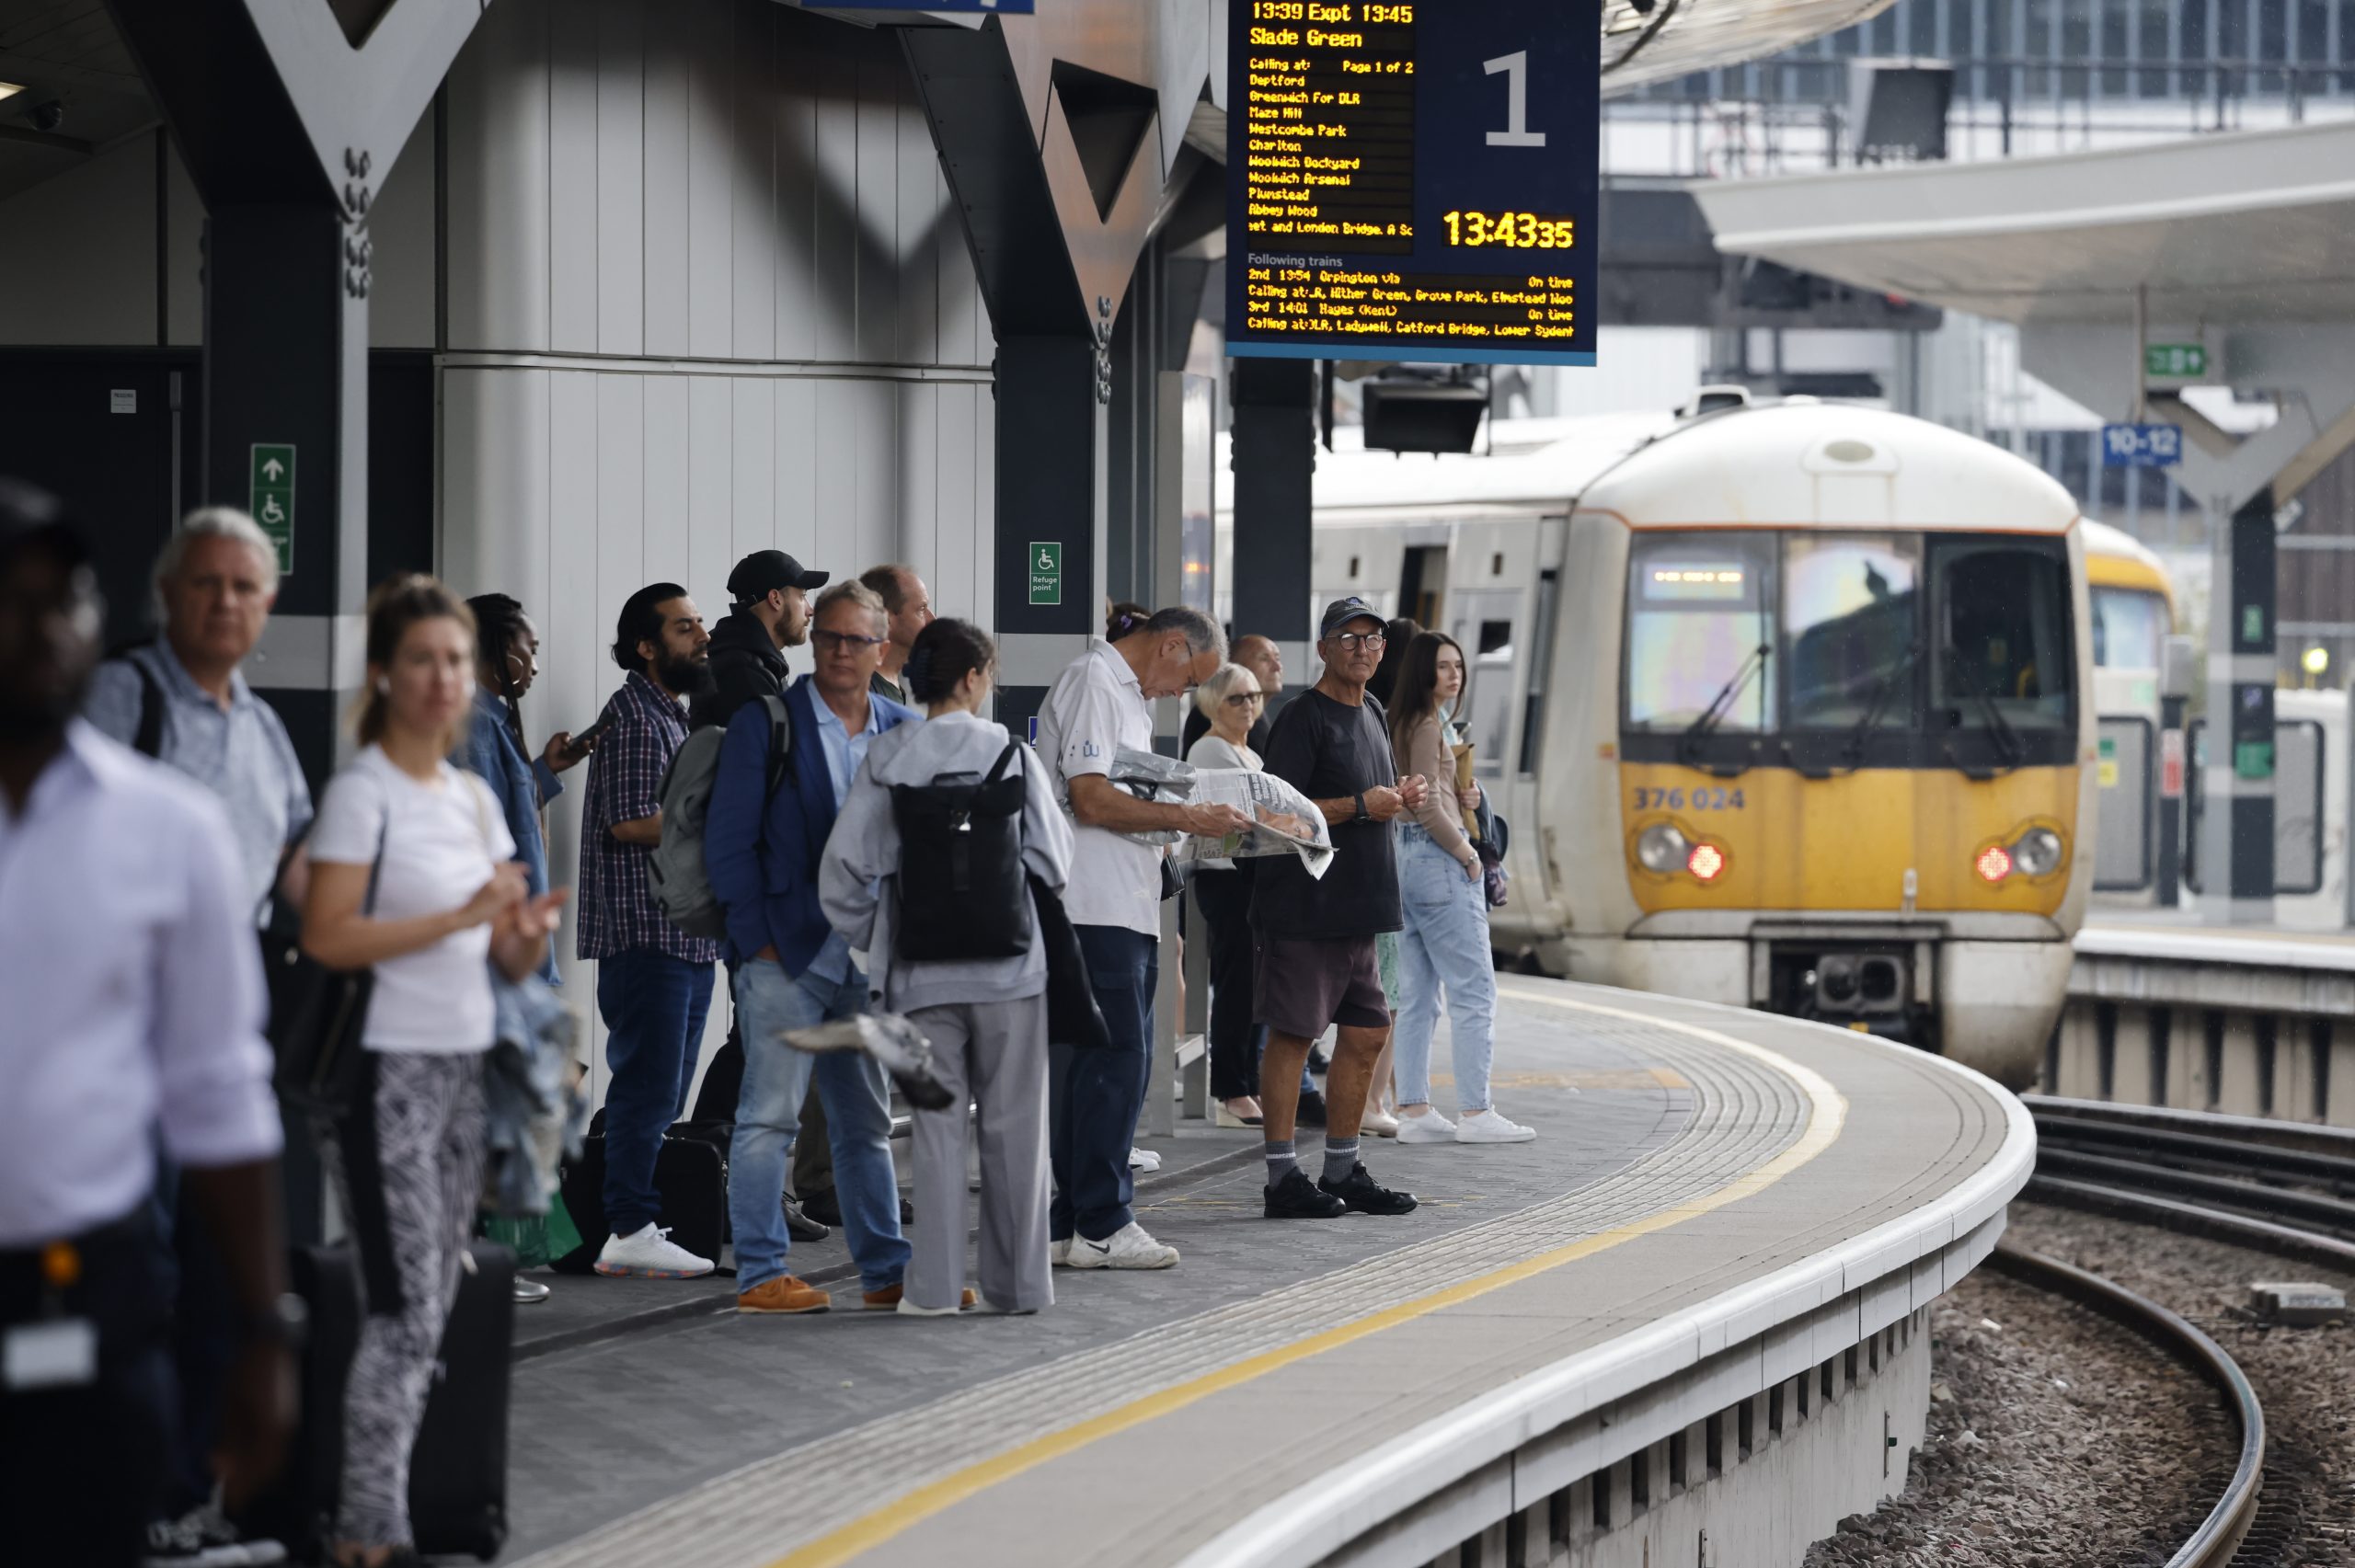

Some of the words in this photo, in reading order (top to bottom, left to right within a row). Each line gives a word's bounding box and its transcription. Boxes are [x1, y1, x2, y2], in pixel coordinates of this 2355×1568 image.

[1254, 3, 1303, 19] 13:39
[1309, 4, 1351, 23] Expt
[1363, 5, 1412, 23] 13:45
[1250, 28, 1298, 45] Slade
[1307, 29, 1361, 47] Green
[1250, 58, 1289, 71] Calling
[1343, 61, 1371, 74] Page
[1376, 62, 1381, 72] 1
[1386, 62, 1400, 73] of
[1406, 63, 1413, 74] 2
[1250, 74, 1304, 86] Deptford
[1250, 91, 1308, 103] Greenwich
[1314, 92, 1334, 103] For
[1338, 93, 1360, 104] DLR
[1483, 50, 1546, 147] 1
[1249, 107, 1279, 118] Maze
[1283, 108, 1302, 119] Hill
[1249, 123, 1314, 135] Westcombe
[1318, 124, 1346, 136] Park
[1249, 140, 1302, 152] Charlton
[1249, 155, 1300, 167] Woolwich
[1304, 156, 1360, 170] Dockyard
[1249, 172, 1299, 183] Woolwich
[1304, 173, 1350, 185] Arsenal
[1249, 188, 1309, 200] Plumstead
[1249, 203, 1283, 216] Abbey
[1288, 205, 1317, 217] Wood
[1272, 222, 1292, 233] and
[1297, 222, 1338, 234] London
[1248, 253, 1305, 268] Following
[1309, 257, 1343, 267] trains
[1249, 269, 1269, 280] 2nd
[1280, 269, 1310, 280] 13:54
[1320, 270, 1377, 284] Orpington
[1382, 273, 1400, 283] via
[1529, 277, 1543, 287] On
[1548, 277, 1572, 288] time
[1248, 284, 1287, 298] Calling
[1330, 287, 1367, 299] Hither
[1373, 288, 1411, 302] Green,
[1416, 290, 1452, 301] Grove
[1455, 292, 1488, 303] Park,
[1492, 292, 1546, 303] Elmstead
[1248, 301, 1269, 312] 3rd
[1280, 302, 1307, 314] 14:01
[1319, 303, 1354, 315] Hayes
[1359, 305, 1396, 315] (Kent)
[1528, 309, 1543, 319] On
[1548, 309, 1572, 320] time
[1248, 317, 1287, 330] Calling
[1337, 320, 1391, 333] Ladywell,
[1396, 321, 1444, 334] Catford
[1449, 324, 1489, 336] Bridge,
[1495, 325, 1531, 336] Lower
[2108, 428, 2177, 455] 10-12
[1634, 786, 1685, 810] 376
[1691, 786, 1745, 810] 024
